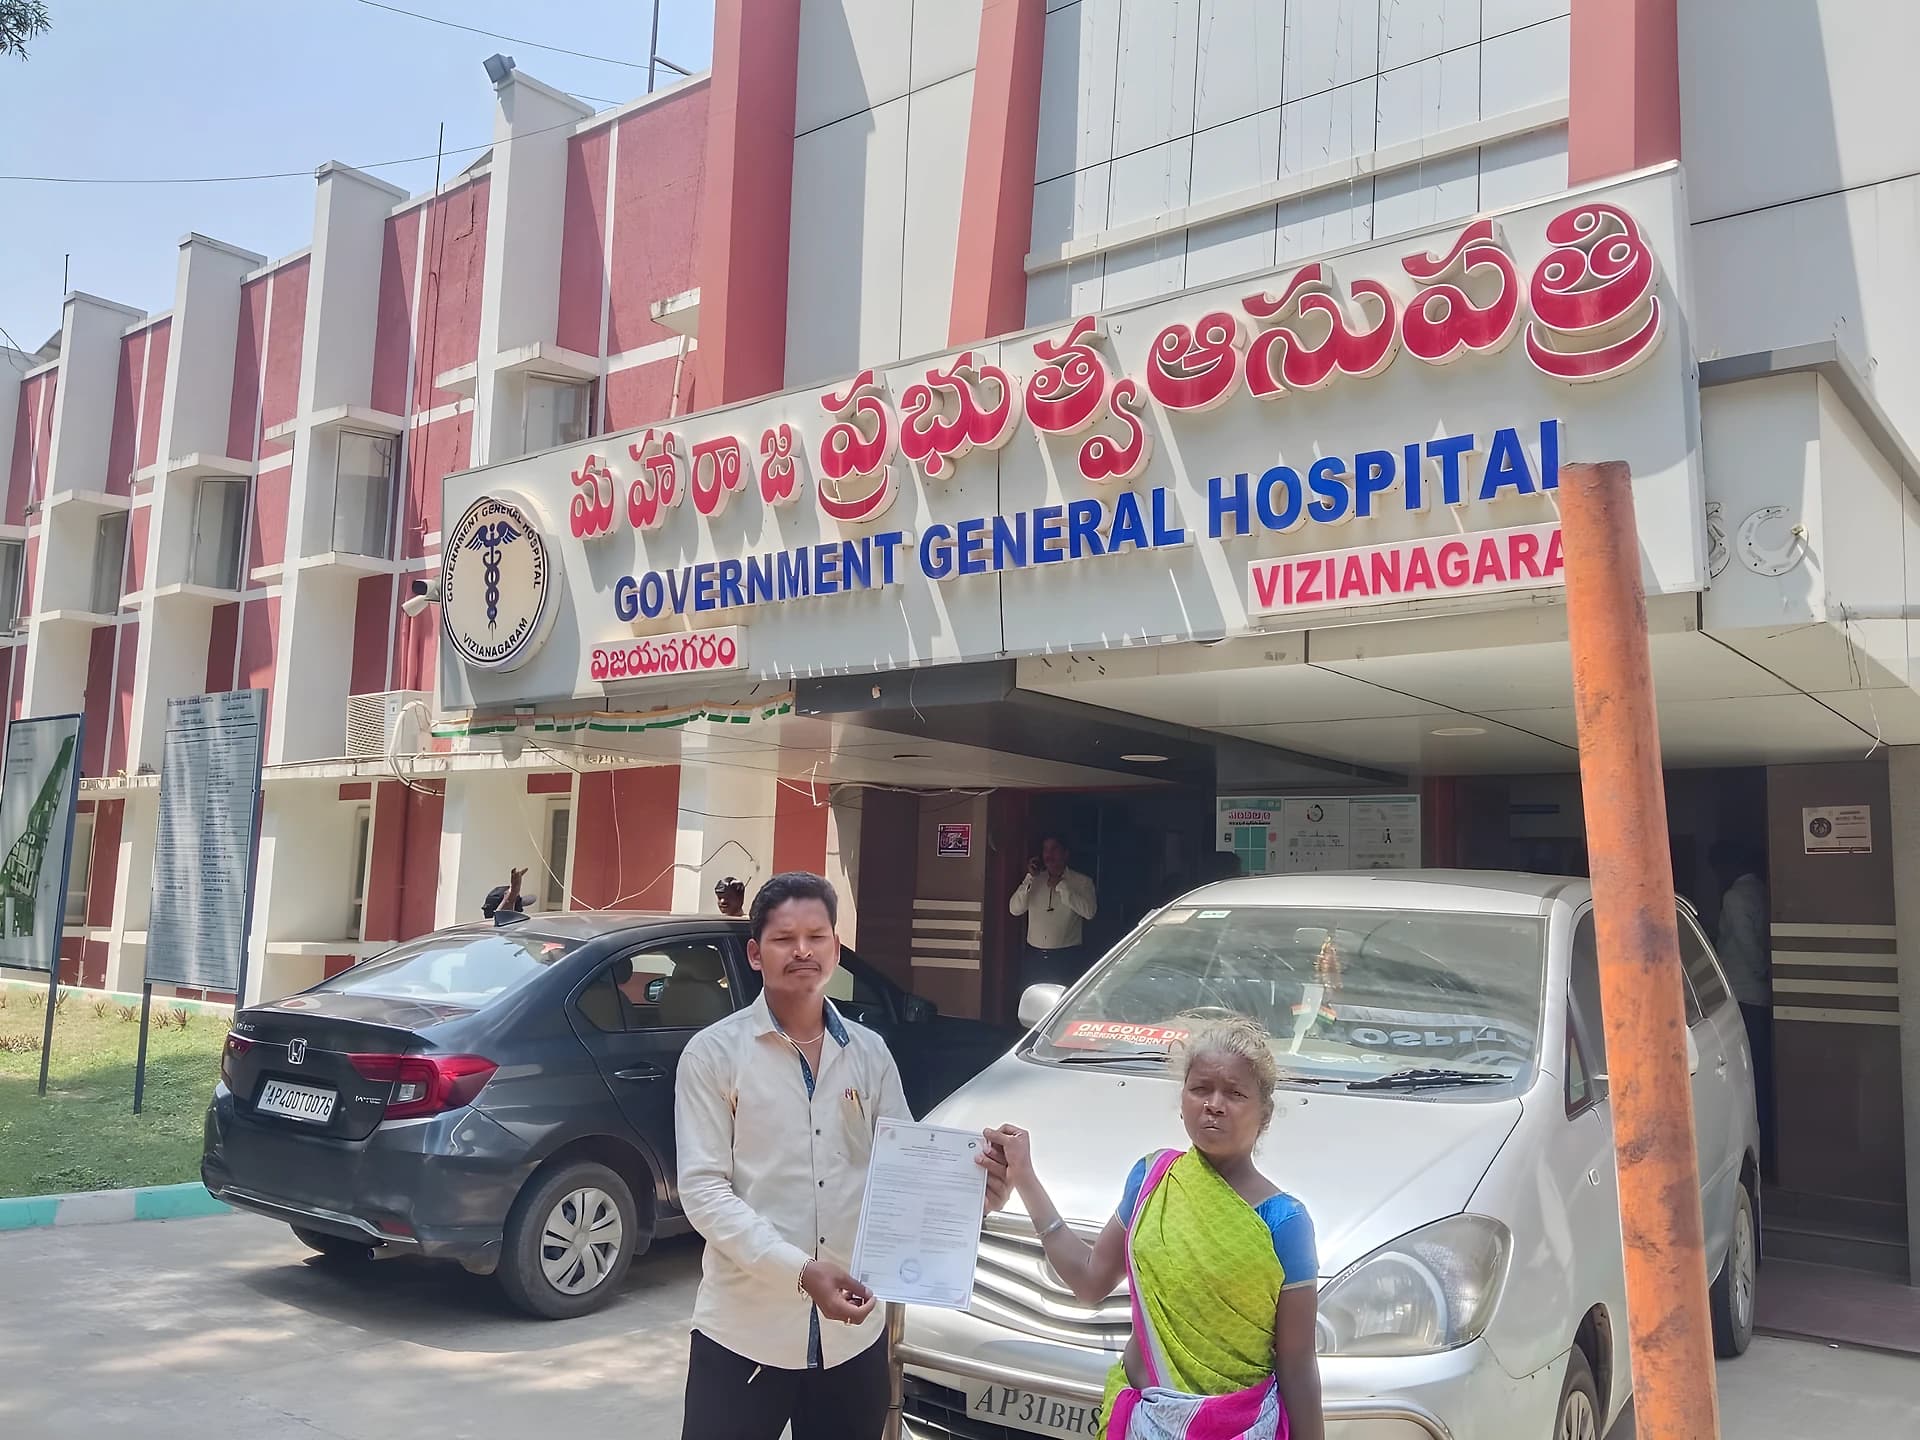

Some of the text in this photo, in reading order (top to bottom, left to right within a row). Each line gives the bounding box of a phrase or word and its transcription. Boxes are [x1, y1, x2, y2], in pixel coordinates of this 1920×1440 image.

[818, 315, 1144, 521] ప్రభుత్వ
[1146, 203, 1660, 409] ఆసుపత్రి
[446, 514, 479, 602] GOVERNMENT
[522, 523, 542, 590] HOSPITAL
[614, 532, 903, 622] GOVERNMENT
[919, 488, 1184, 579] GENERAL
[1252, 529, 1566, 608] VIZIANAGARA
[463, 617, 529, 657] VIZIANAGARAM
[591, 633, 736, 679] విజయనగరం
[1077, 1023, 1104, 1032] ON
[1108, 1024, 1160, 1035] GOVT
[973, 1385, 1104, 1437] AP31BH8
